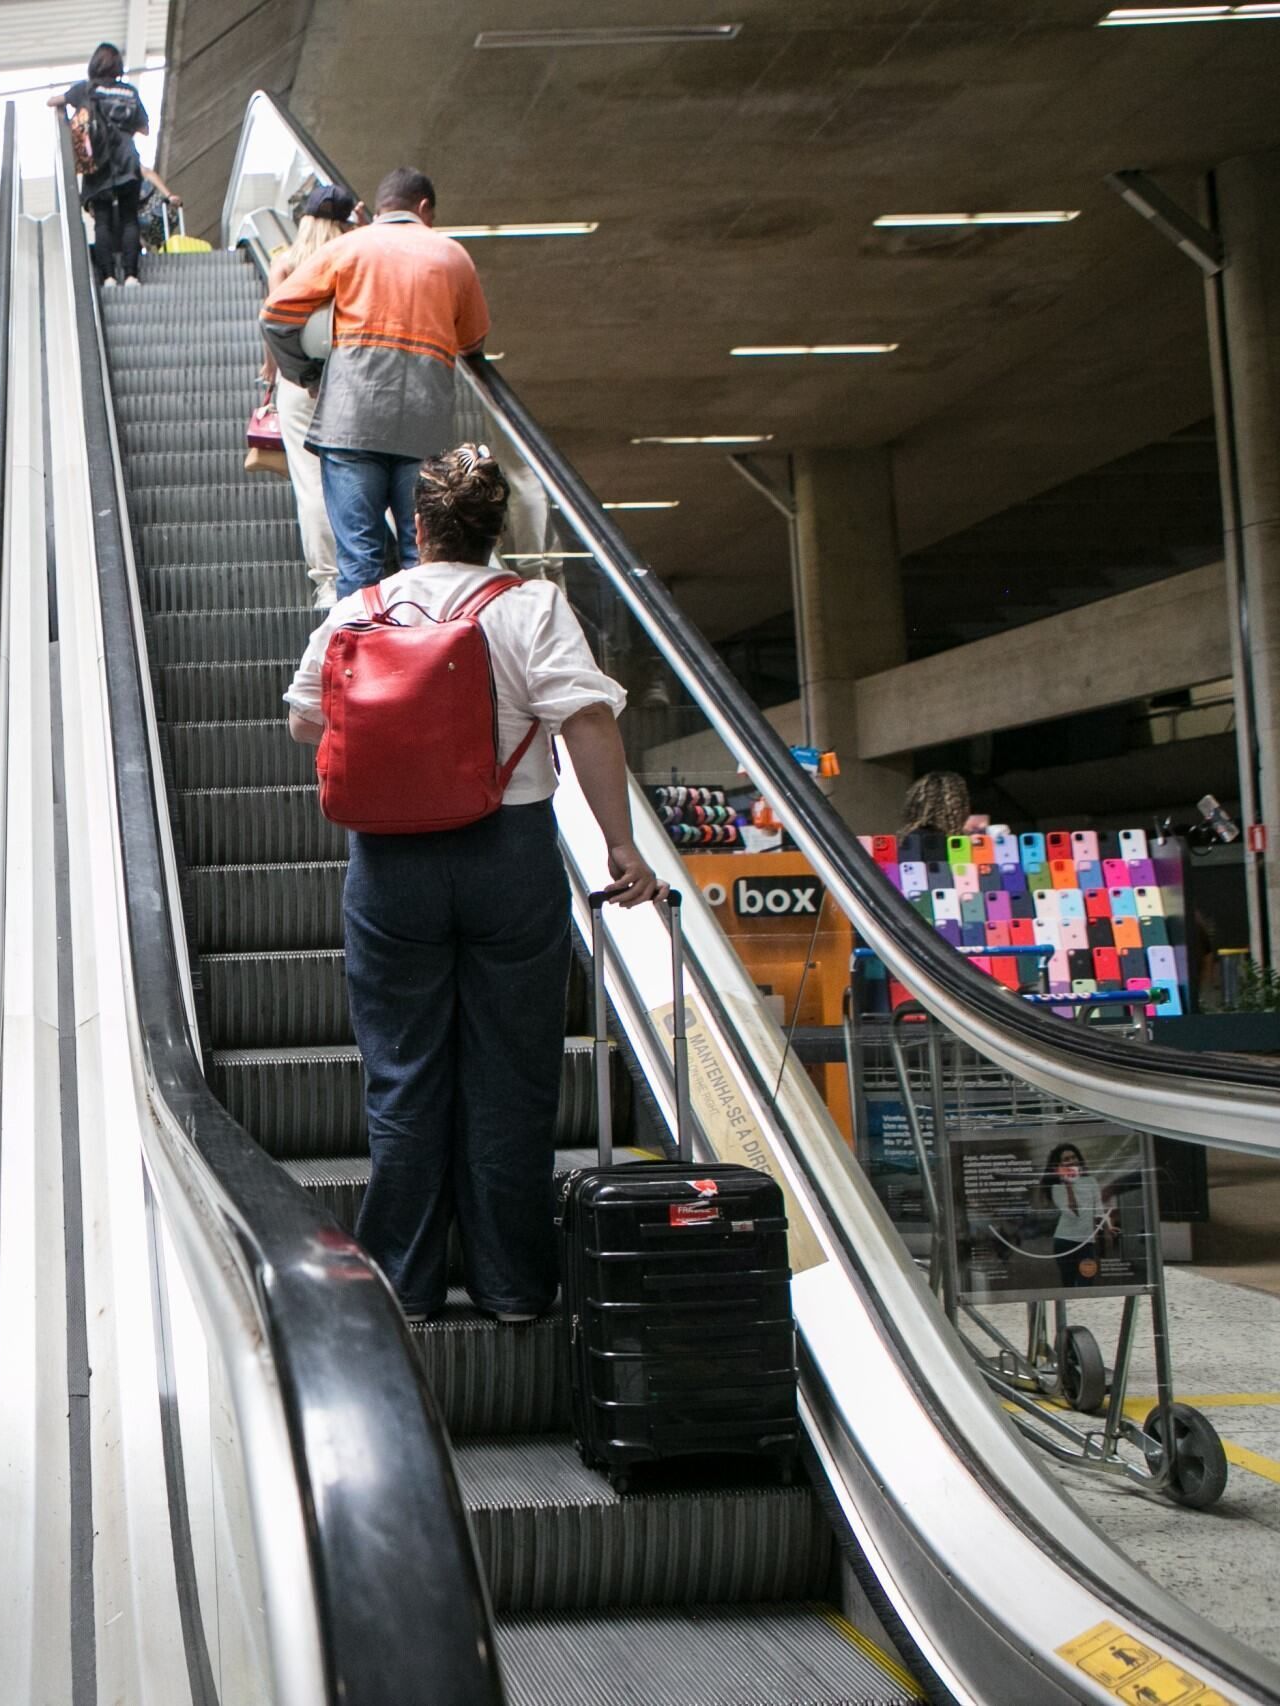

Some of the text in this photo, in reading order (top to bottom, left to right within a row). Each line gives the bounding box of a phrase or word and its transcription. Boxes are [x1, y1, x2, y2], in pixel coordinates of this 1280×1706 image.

[738, 880, 816, 913] box
[690, 1034, 774, 1177] MANTENHA-SE À DIRE
